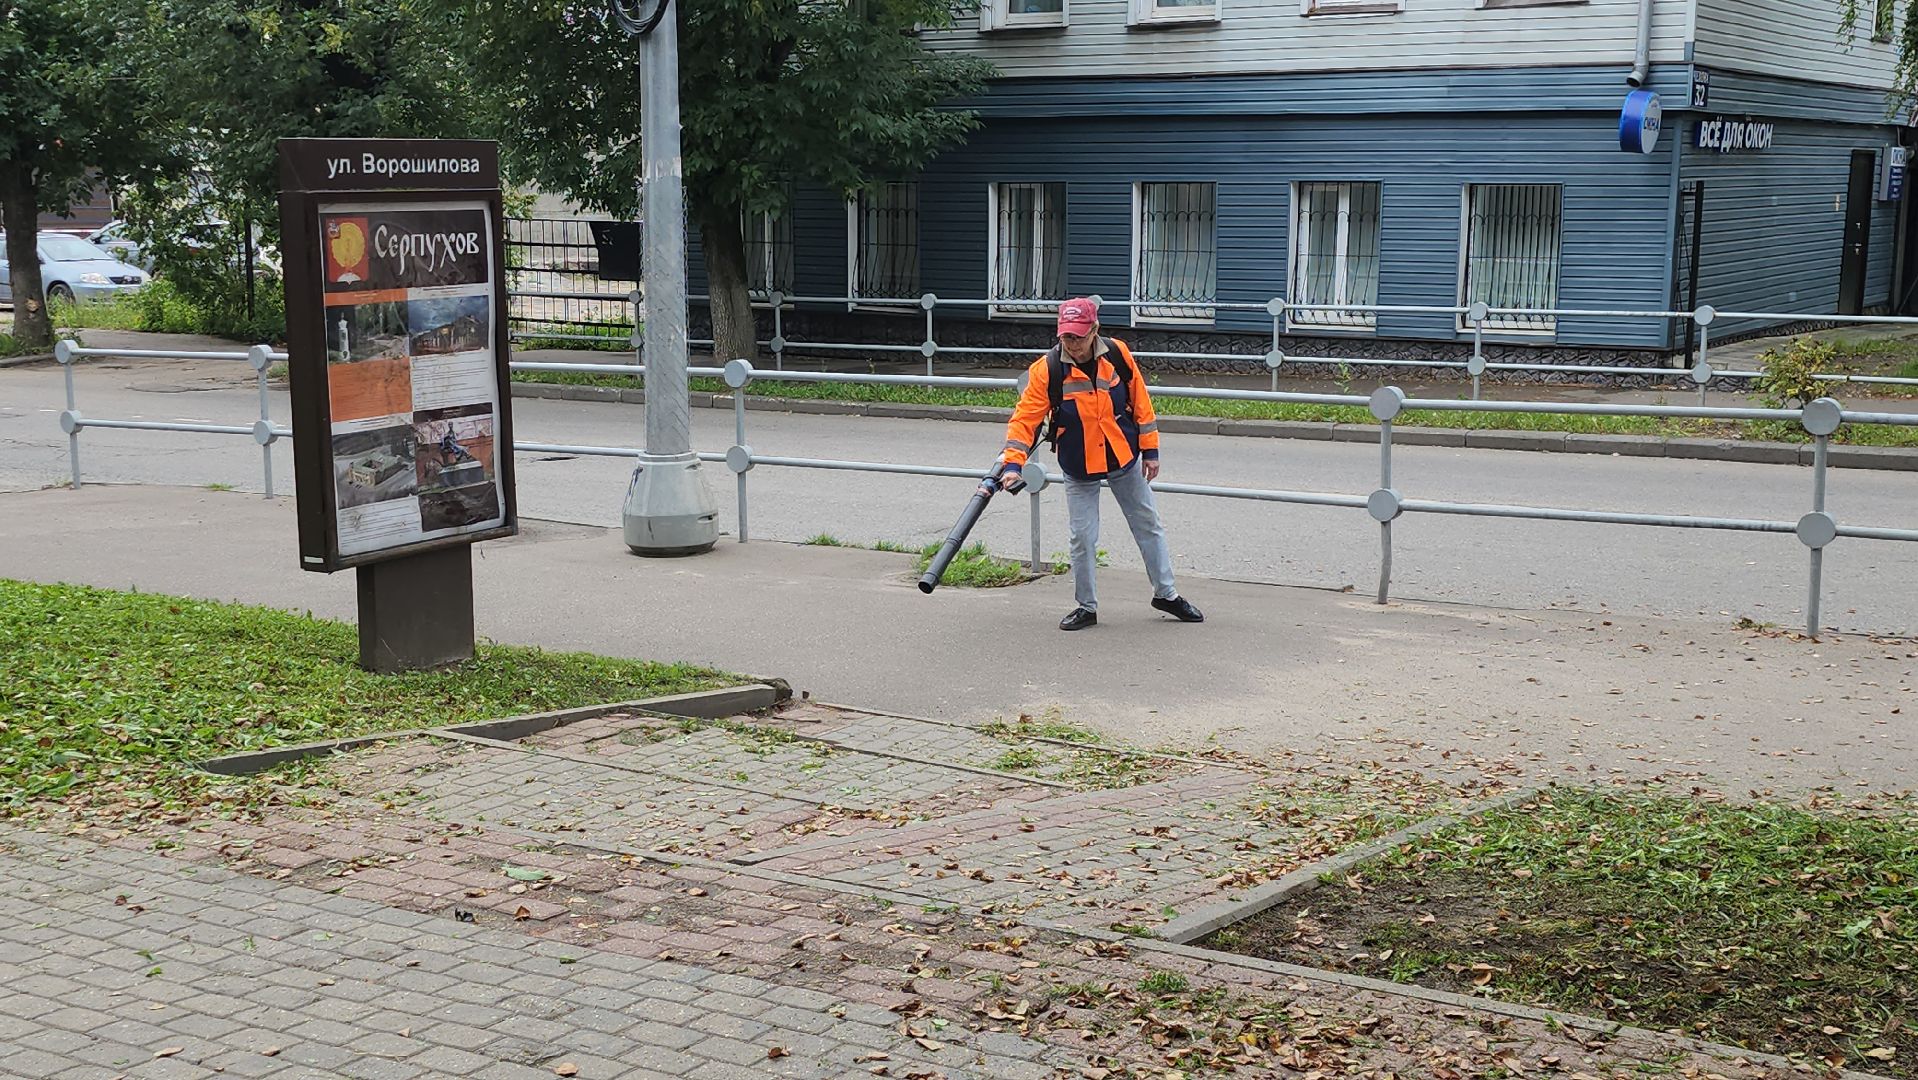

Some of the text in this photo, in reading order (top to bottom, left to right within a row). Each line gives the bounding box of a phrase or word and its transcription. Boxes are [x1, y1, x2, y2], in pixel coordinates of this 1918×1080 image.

[1694, 84, 1706, 106] 32
[1699, 115, 1774, 153] ВСЁ ДЛЯ ОКОН
[327, 152, 480, 179] ул. Ворошилова
[374, 224, 480, 276] Серпухов
